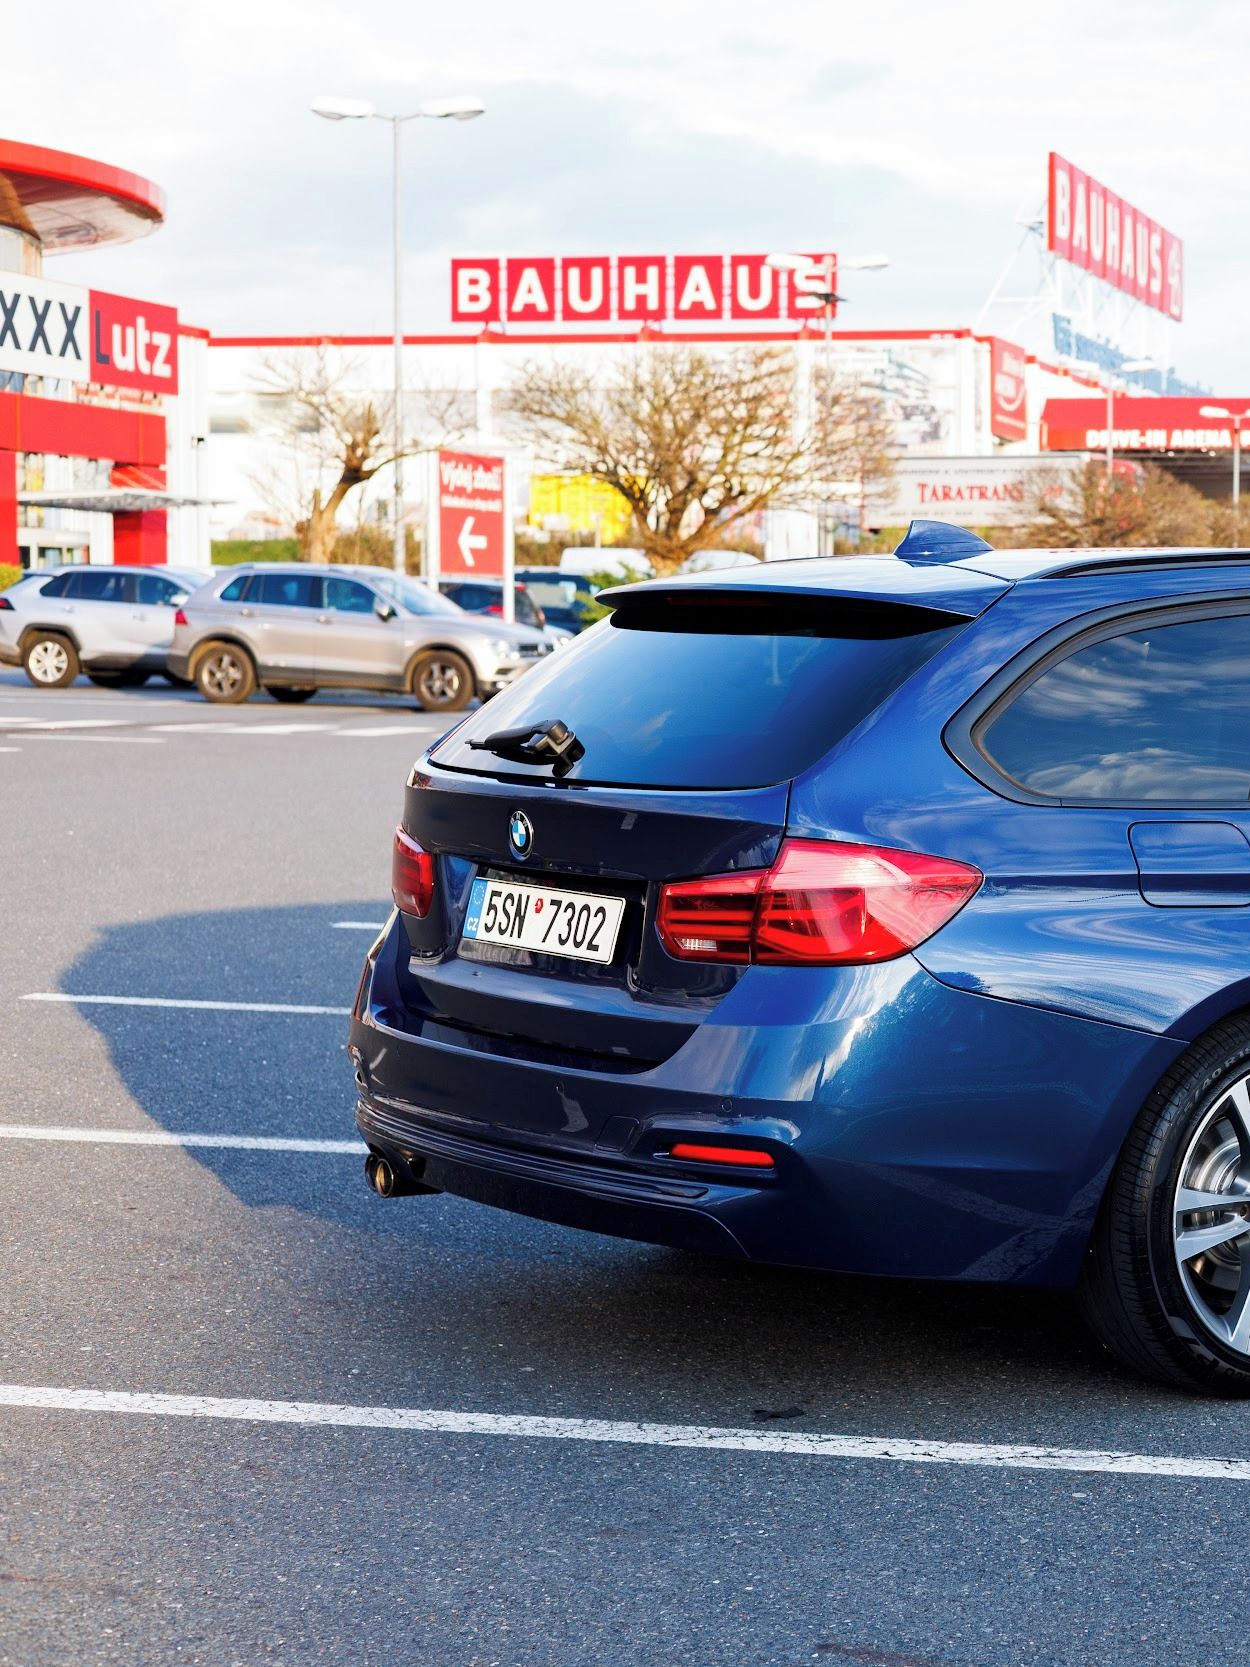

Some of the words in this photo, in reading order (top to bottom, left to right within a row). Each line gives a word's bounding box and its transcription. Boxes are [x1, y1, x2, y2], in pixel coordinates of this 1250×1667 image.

[1056, 168, 1162, 295] BAUHAUS
[457, 263, 831, 314] BAUHAUS
[1170, 429, 1232, 448] ARENA
[466, 917, 479, 931] CZ
[484, 889, 530, 939] 5SN
[541, 898, 607, 952] 7302
